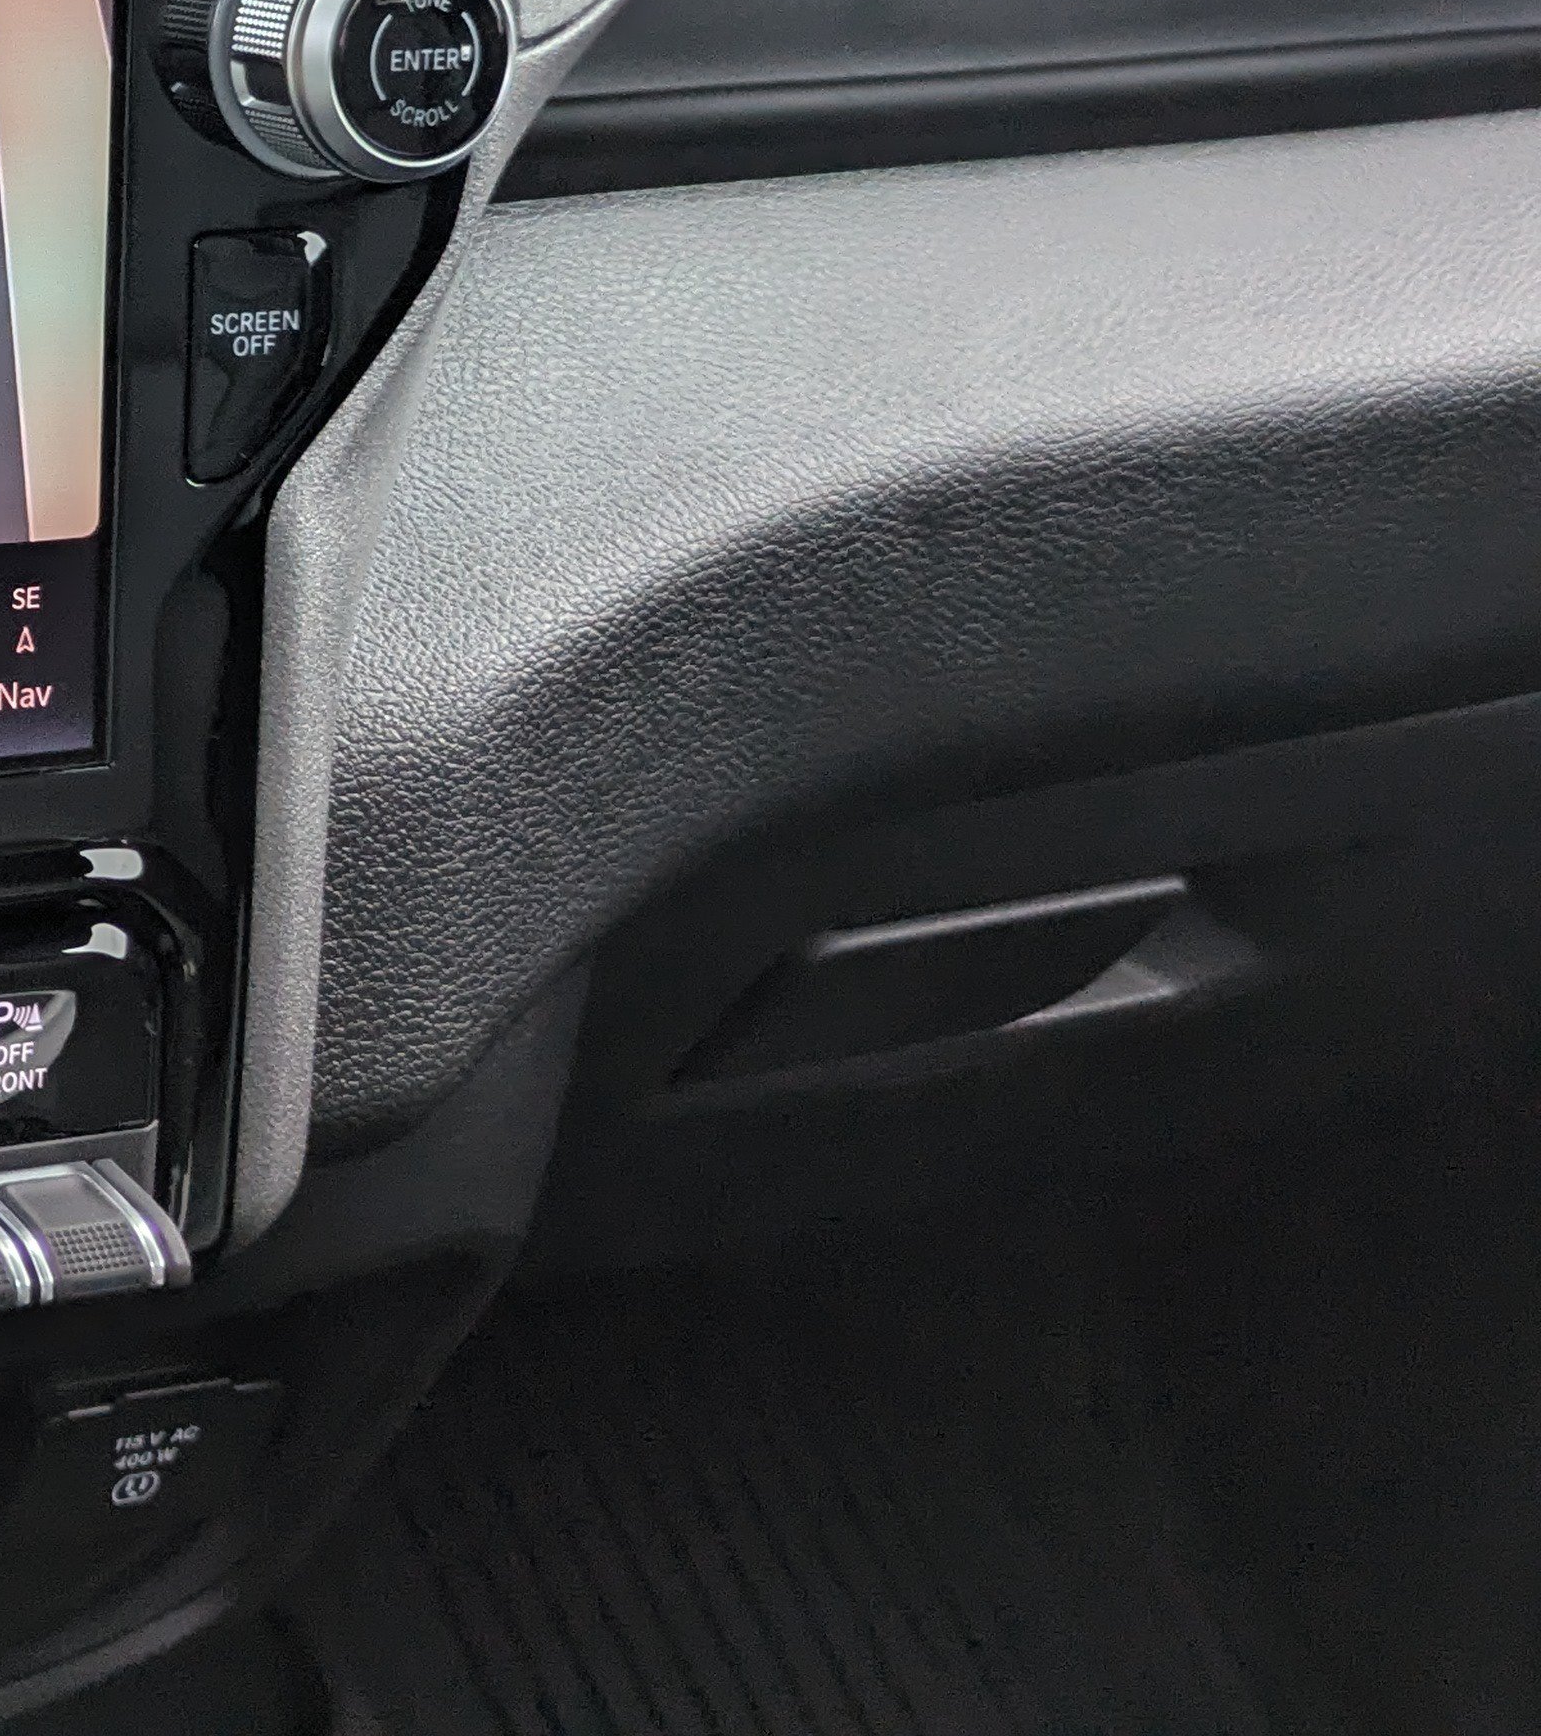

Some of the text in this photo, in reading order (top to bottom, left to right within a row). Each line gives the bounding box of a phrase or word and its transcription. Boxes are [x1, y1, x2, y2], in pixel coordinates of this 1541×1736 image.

[391, 48, 462, 71] ENTER
[390, 98, 459, 128] SCROLL
[210, 310, 299, 336] SCREEN
[232, 335, 277, 357] OFF
[11, 586, 41, 610] SE
